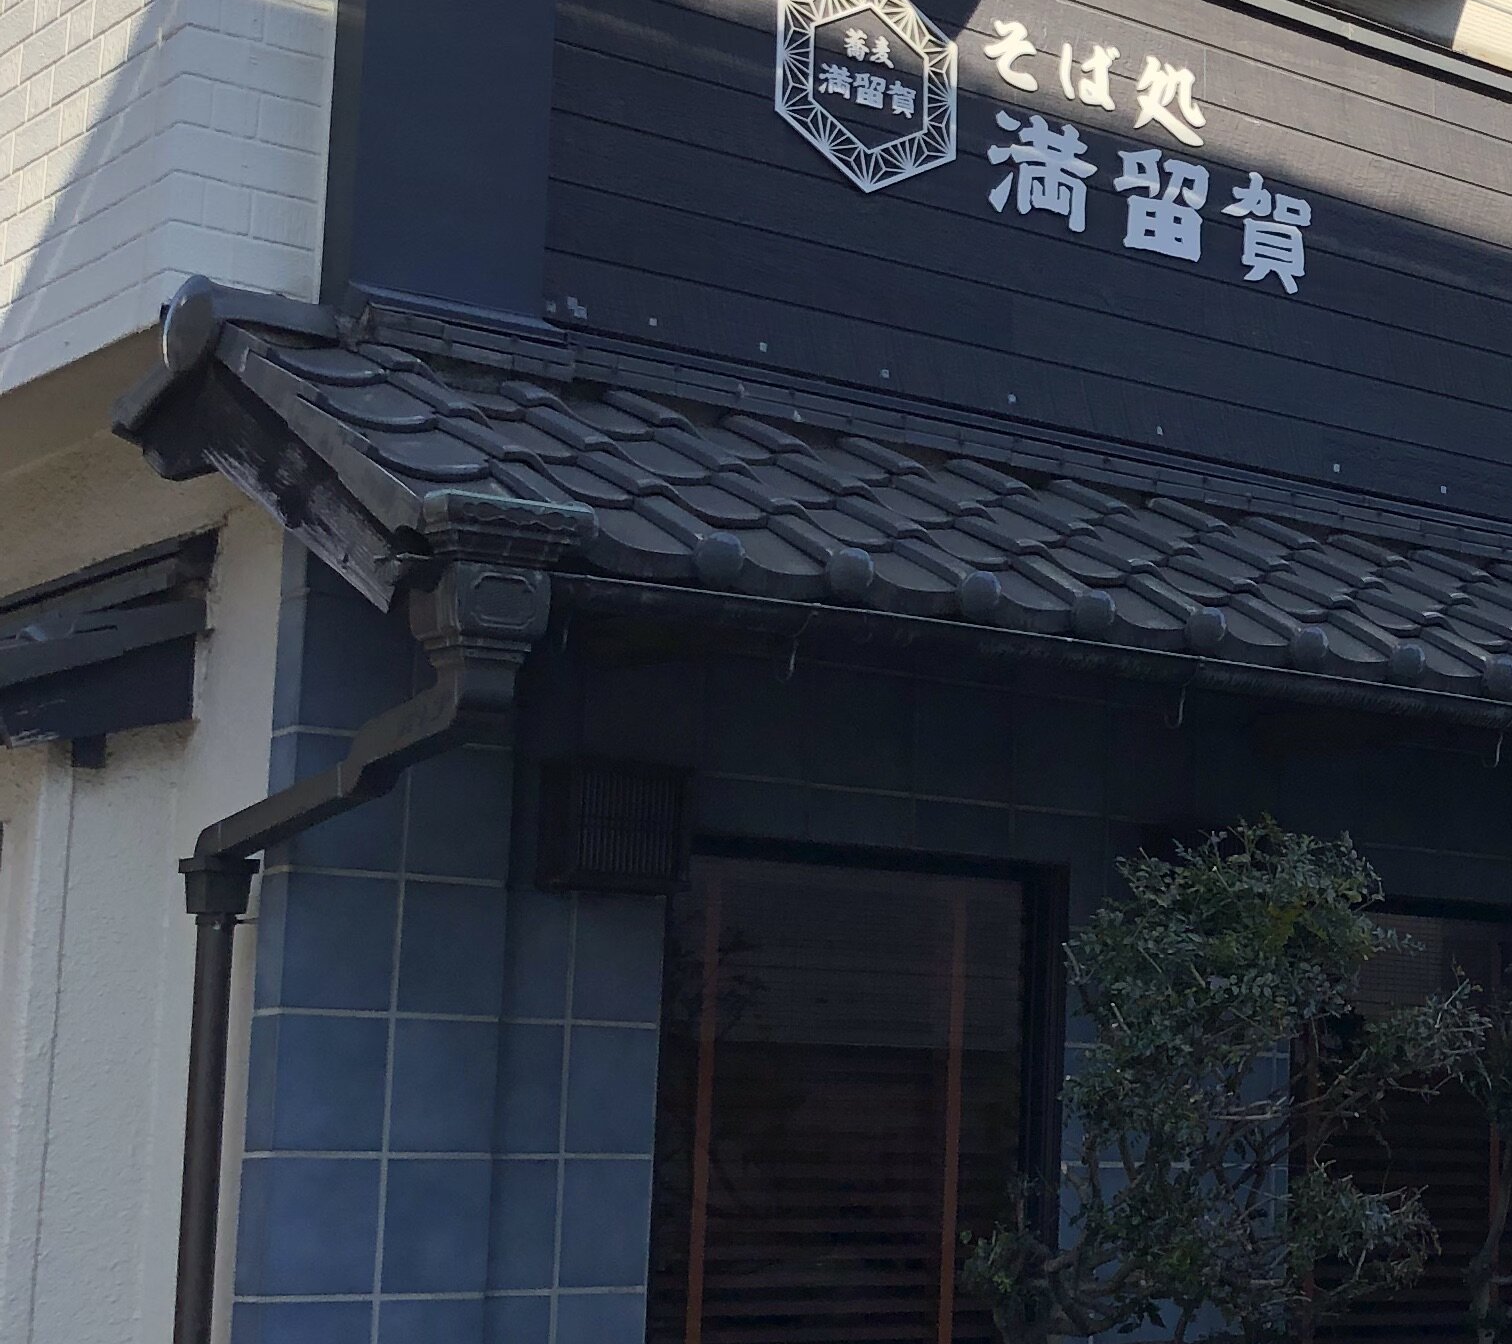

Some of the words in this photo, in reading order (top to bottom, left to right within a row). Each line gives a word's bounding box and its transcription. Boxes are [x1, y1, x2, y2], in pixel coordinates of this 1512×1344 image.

[817, 62, 917, 119] 満留賀
[843, 27, 895, 69] 蕎麦
[983, 19, 1207, 147] そば処
[986, 110, 1311, 295] 満留賀
